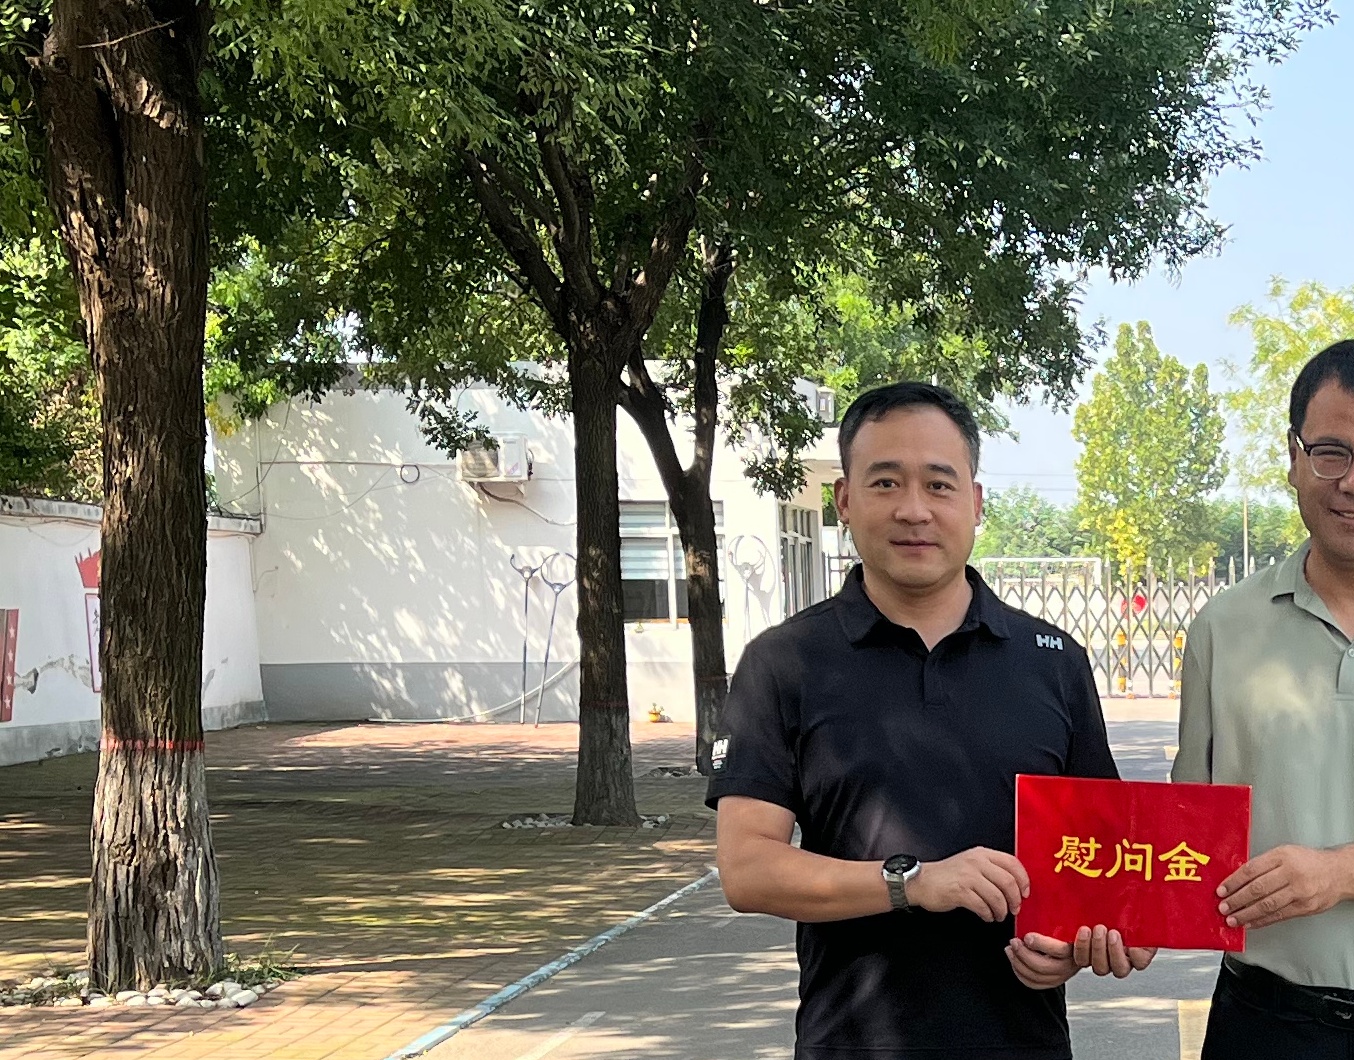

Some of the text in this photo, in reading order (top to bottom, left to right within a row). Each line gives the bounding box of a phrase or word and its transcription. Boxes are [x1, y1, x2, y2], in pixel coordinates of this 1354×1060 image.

[1035, 634, 1064, 650] HH
[1053, 835, 1211, 882] 慰问金
